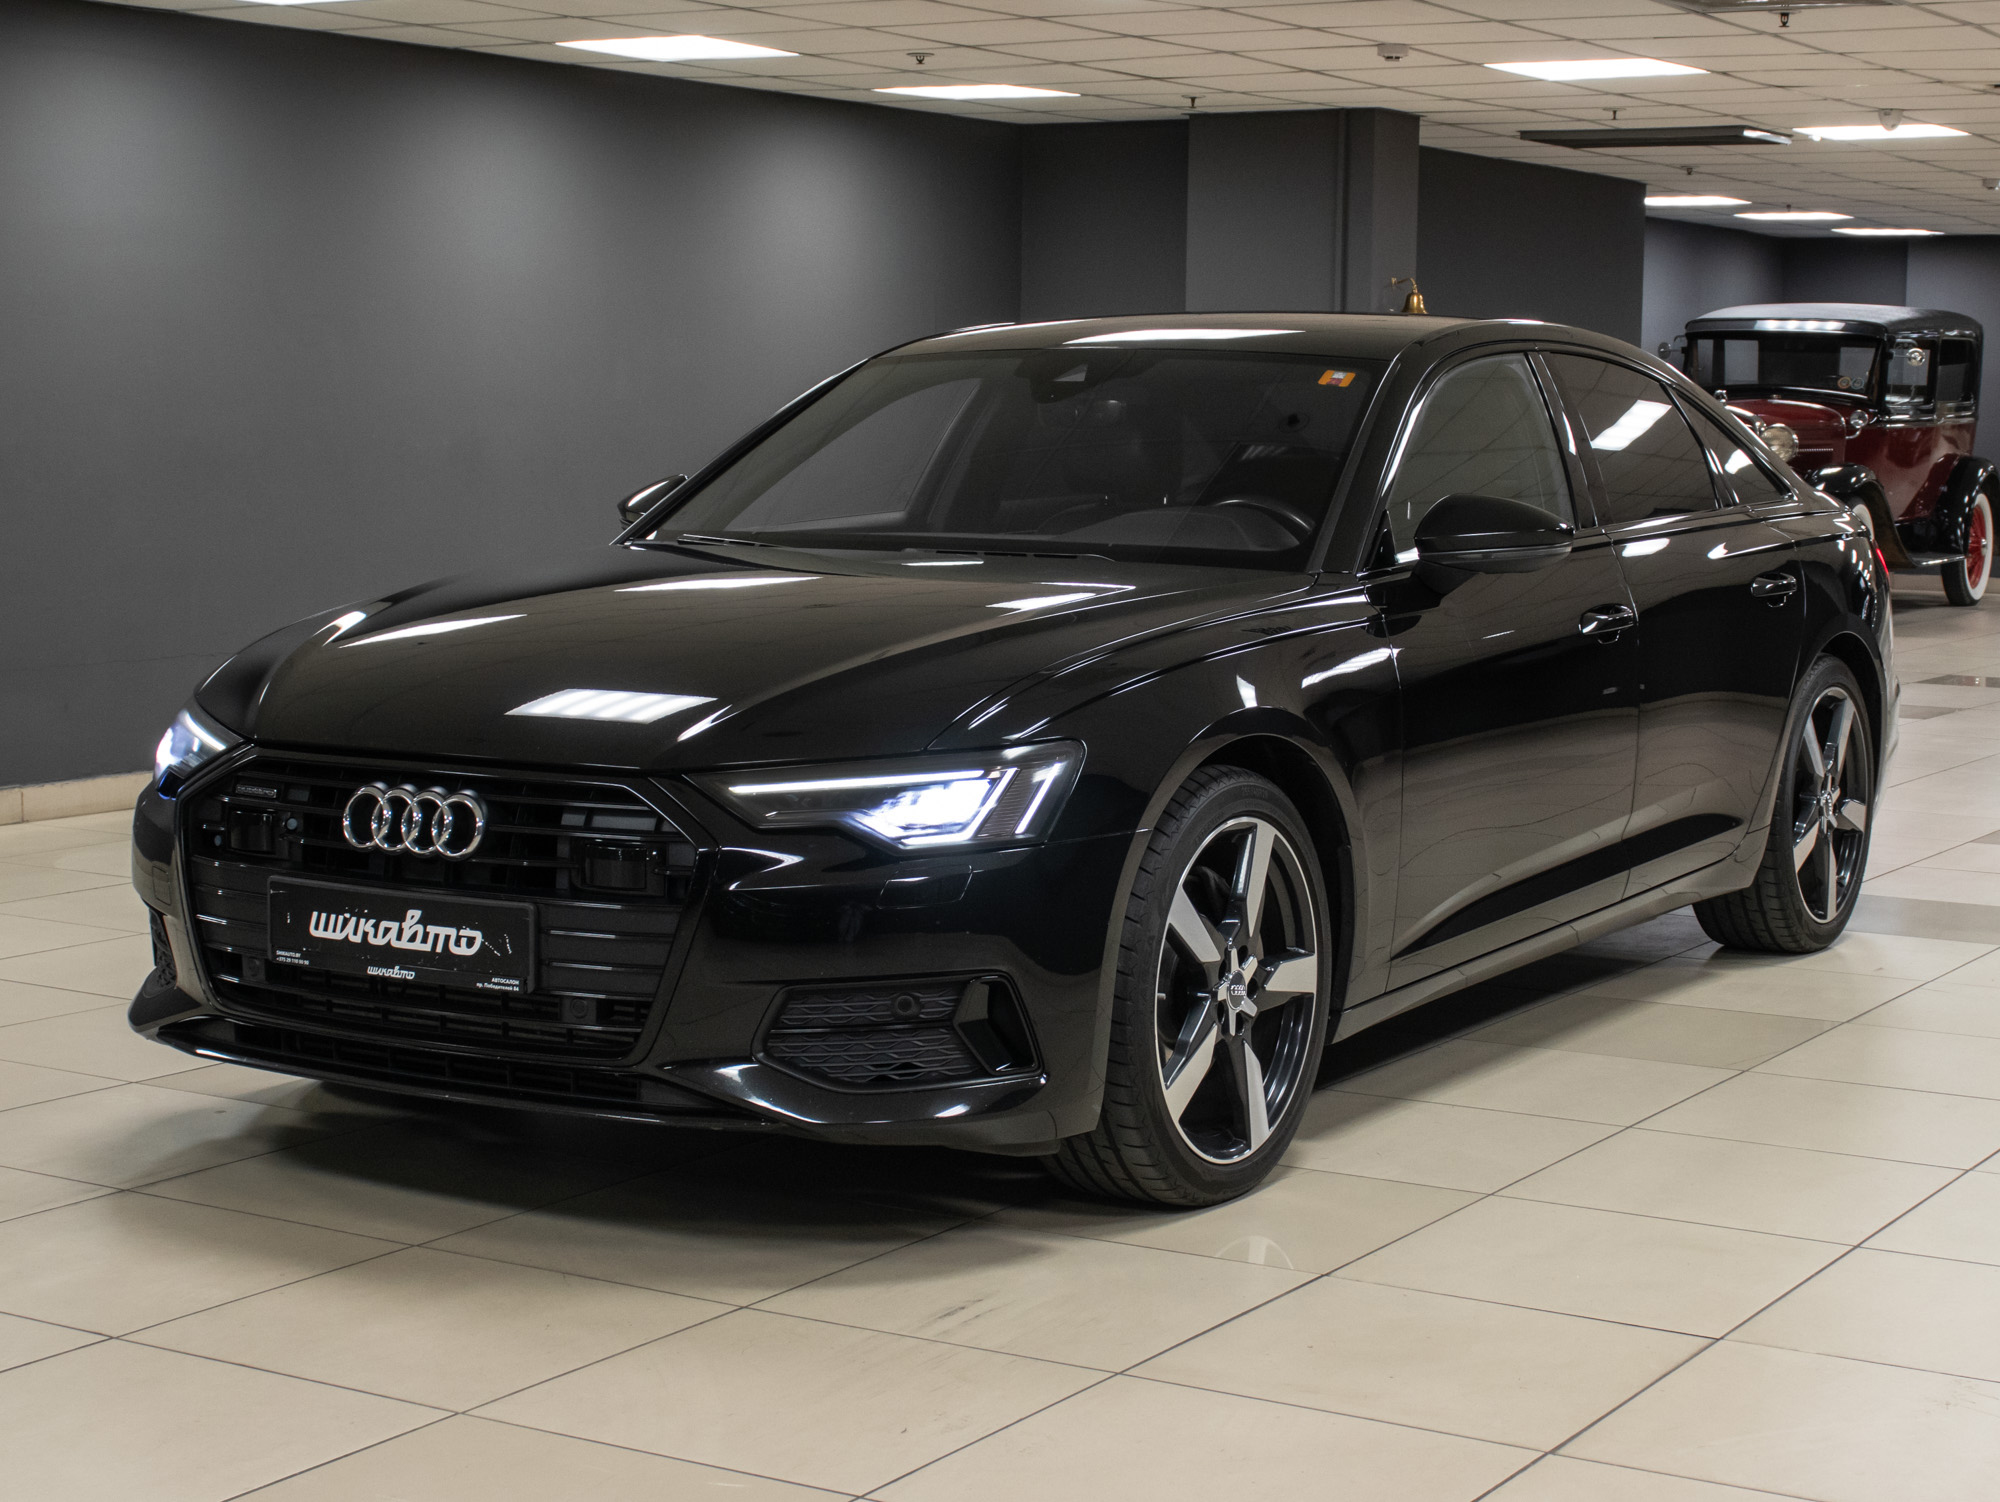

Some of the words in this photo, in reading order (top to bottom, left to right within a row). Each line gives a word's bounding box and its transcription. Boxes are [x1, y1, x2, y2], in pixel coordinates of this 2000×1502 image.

[309, 909, 482, 956] шикавто
[367, 965, 416, 980] шикавто
[491, 977, 520, 985] АВТОСАЛОН
